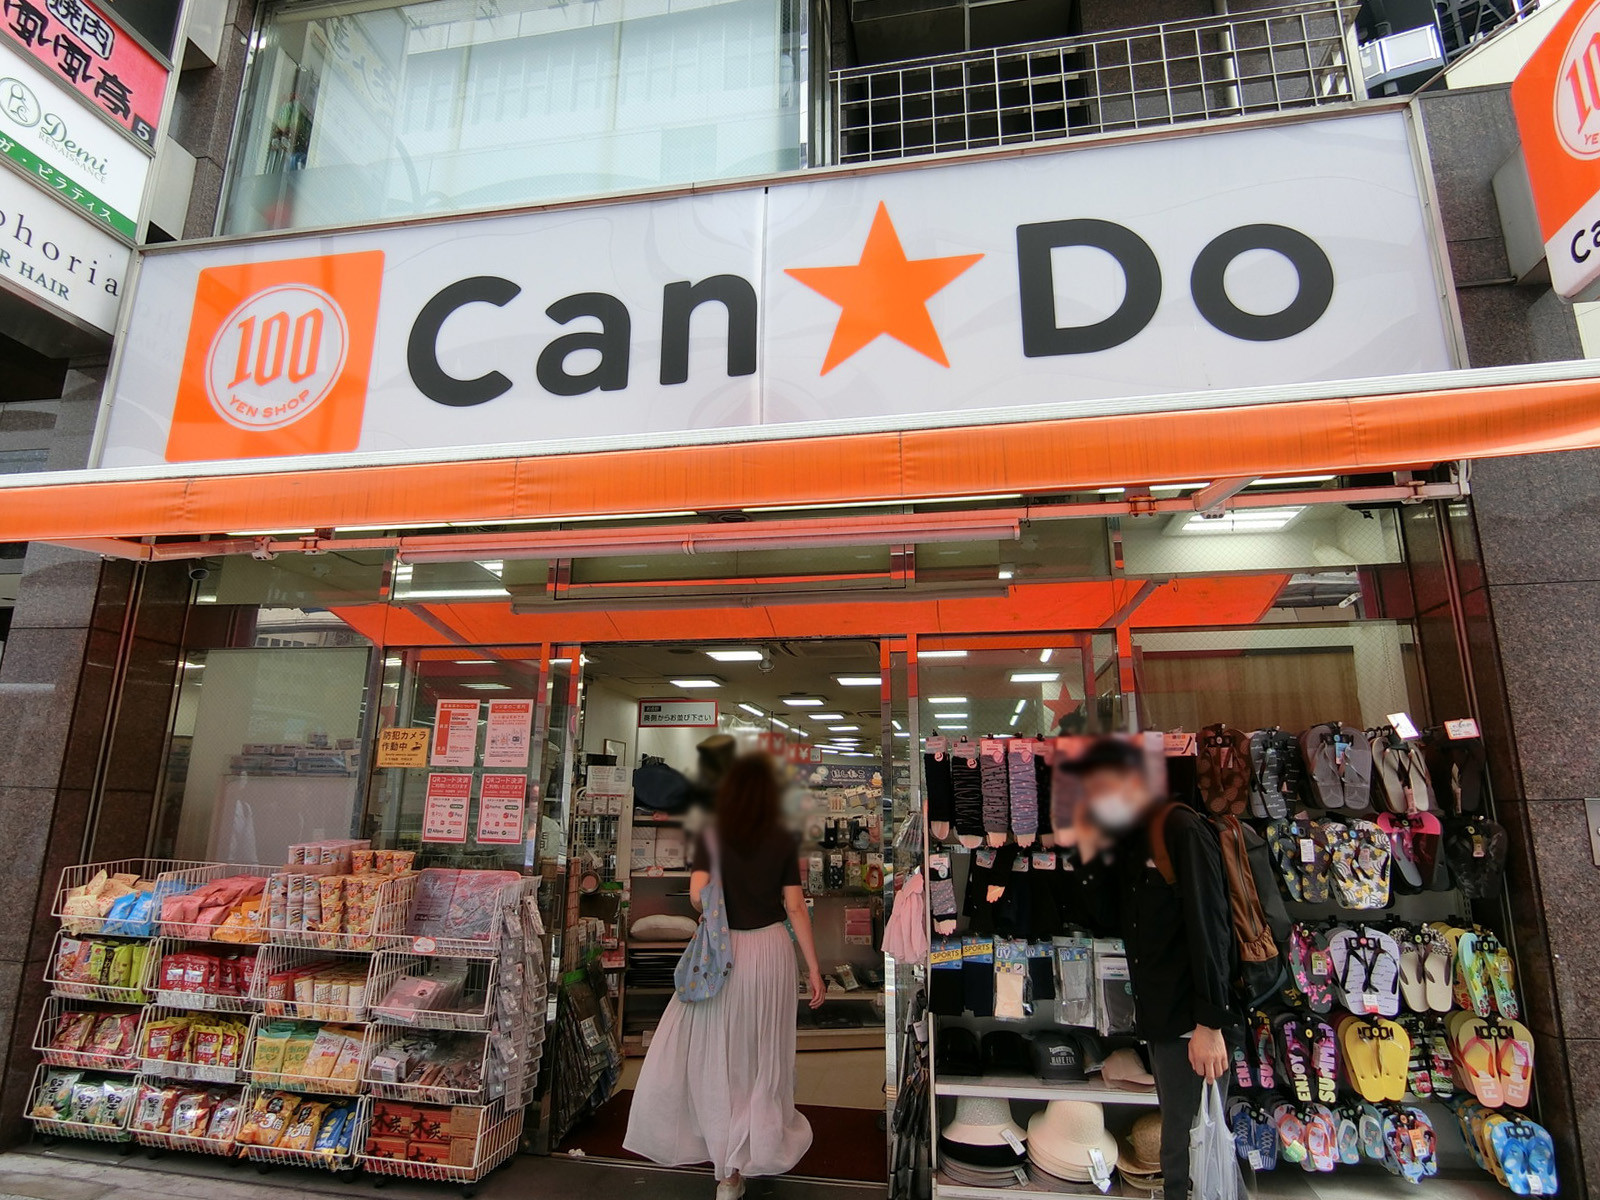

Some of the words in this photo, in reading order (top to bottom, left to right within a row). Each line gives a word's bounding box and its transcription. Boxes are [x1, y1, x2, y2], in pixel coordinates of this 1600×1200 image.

[41, 113, 108, 176] Demi
[135, 124, 151, 141] 5
[38, 132, 106, 184] RENAISSANCE
[19, 260, 70, 301] HAIR
[407, 273, 757, 406] Can
[1016, 218, 1335, 358] Do
[227, 308, 324, 389] 100
[229, 393, 259, 418] YEN
[262, 388, 310, 419] SHOP
[381, 741, 408, 751] 作動中
[382, 731, 427, 741] 防犯カメラ
[932, 951, 960, 960] SPORTS
[963, 943, 990, 953] SPORTS
[995, 945, 1011, 959] UV
[1025, 944, 1036, 956] UV
[1289, 1053, 1312, 1102] ENJOY
[371, 1105, 402, 1133] 木炭
[409, 1112, 441, 1139] 木炭
